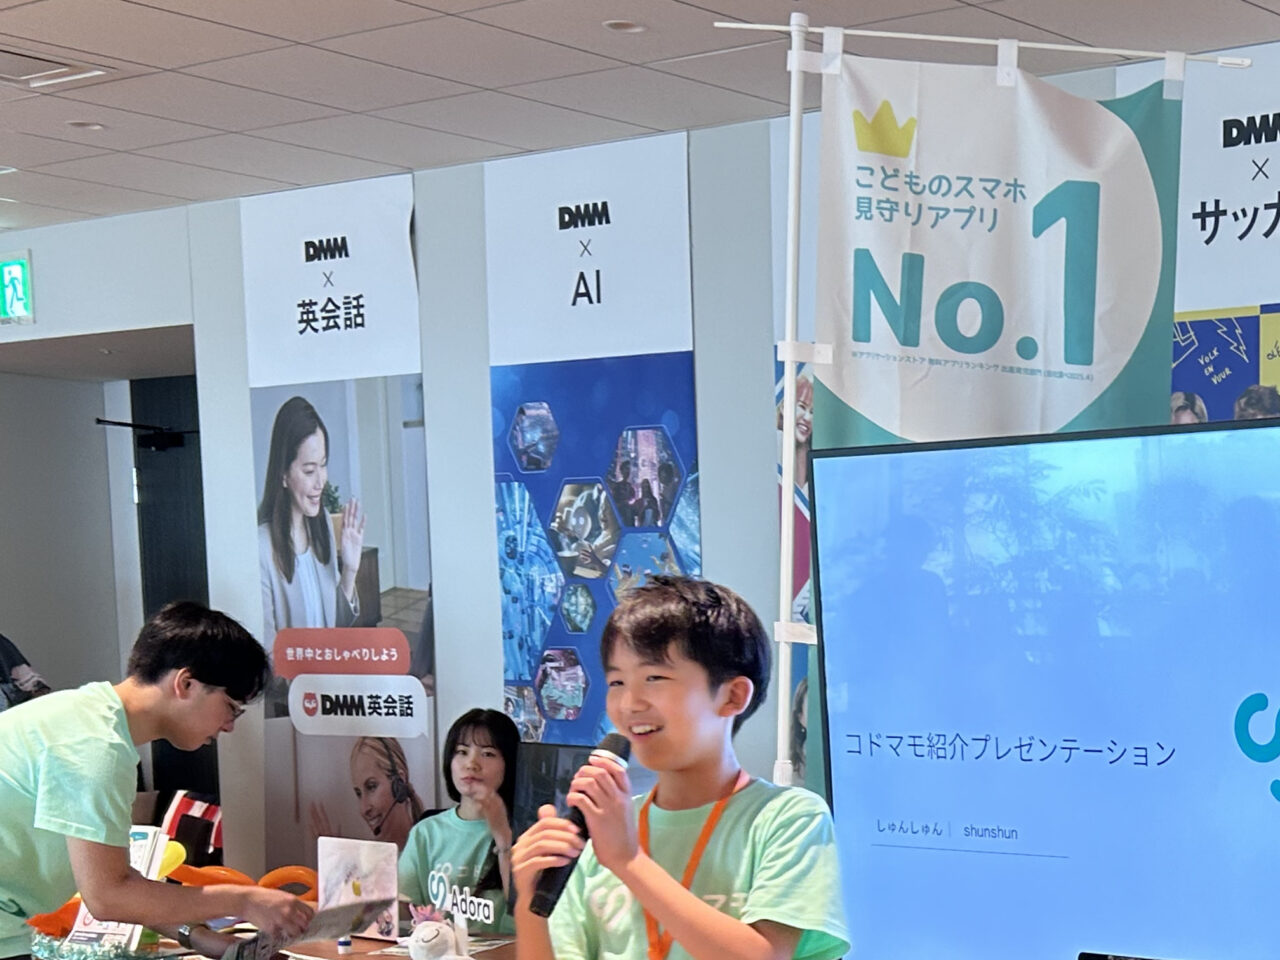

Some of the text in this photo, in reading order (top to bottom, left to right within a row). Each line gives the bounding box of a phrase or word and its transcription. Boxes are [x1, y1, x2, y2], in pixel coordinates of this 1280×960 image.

[855, 166, 1028, 203] こどものスマホ
[558, 201, 611, 230] DMM
[855, 196, 999, 233] 見守りアプリ
[304, 236, 350, 263] DMM
[571, 270, 602, 307] AI
[851, 179, 1101, 367] No.1
[296, 294, 366, 335] 英会話
[286, 647, 398, 662] 世界中とおしゃべりしよう
[845, 731, 1177, 768] コドマモ紹介プレゼンテーション
[876, 819, 1019, 840] しゅんしゅん shunshun
[451, 888, 491, 921] Adora
